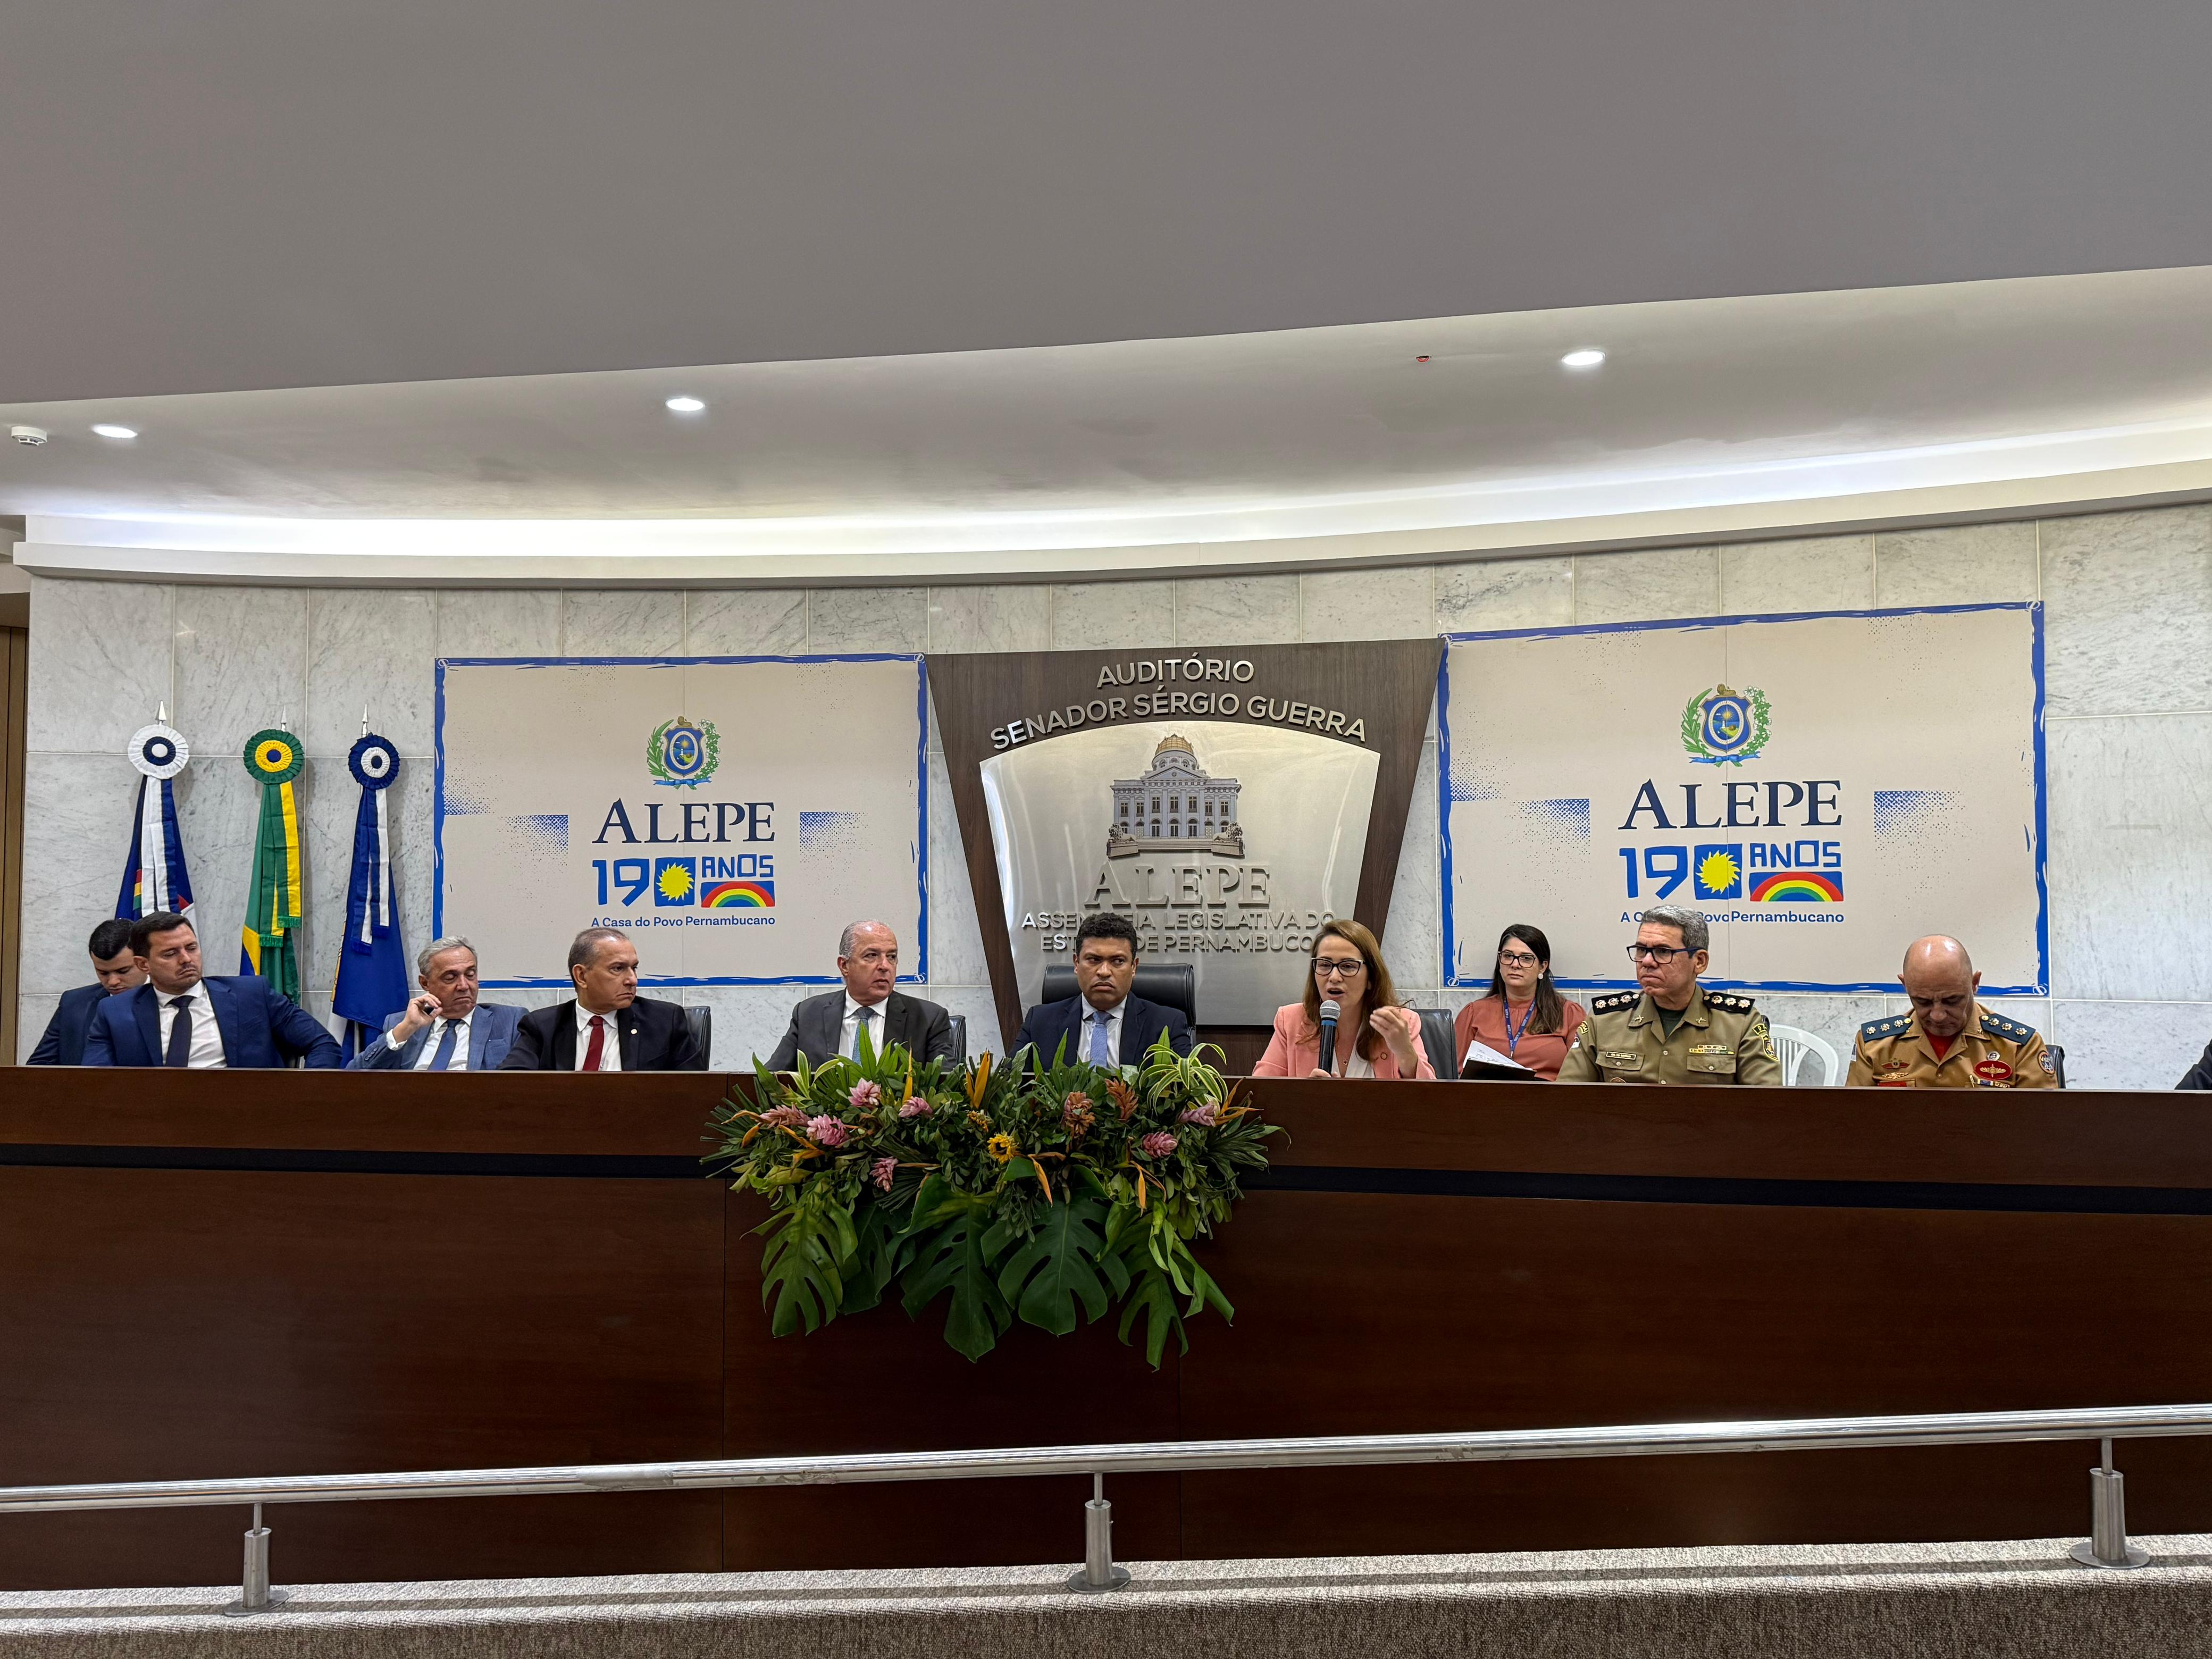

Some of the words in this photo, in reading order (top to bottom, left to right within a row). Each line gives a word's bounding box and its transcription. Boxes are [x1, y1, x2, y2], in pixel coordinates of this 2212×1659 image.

[1096, 652, 1254, 689] AUDITÓRIO
[990, 697, 1129, 749] SENADOR
[1133, 685, 1240, 716] SÉRGIO
[1247, 696, 1365, 742] GUERRA
[1618, 778, 1842, 830] ALEPE
[591, 798, 775, 844] ALEPE
[702, 854, 774, 878] ANOS
[1749, 840, 1841, 868] ANOS
[1083, 858, 1270, 909] ALEPE
[591, 917, 600, 927] A
[602, 917, 632, 927] Casa
[635, 916, 650, 927] do
[653, 917, 683, 927] Povo
[685, 915, 775, 926] Pernambucano
[1164, 911, 1301, 930] LEGISLATIVA
[1305, 910, 1335, 929] DO
[1620, 911, 1630, 922] A
[1731, 910, 1844, 923] Pernambucano
[1164, 933, 1313, 953] PERNAMBUCO
